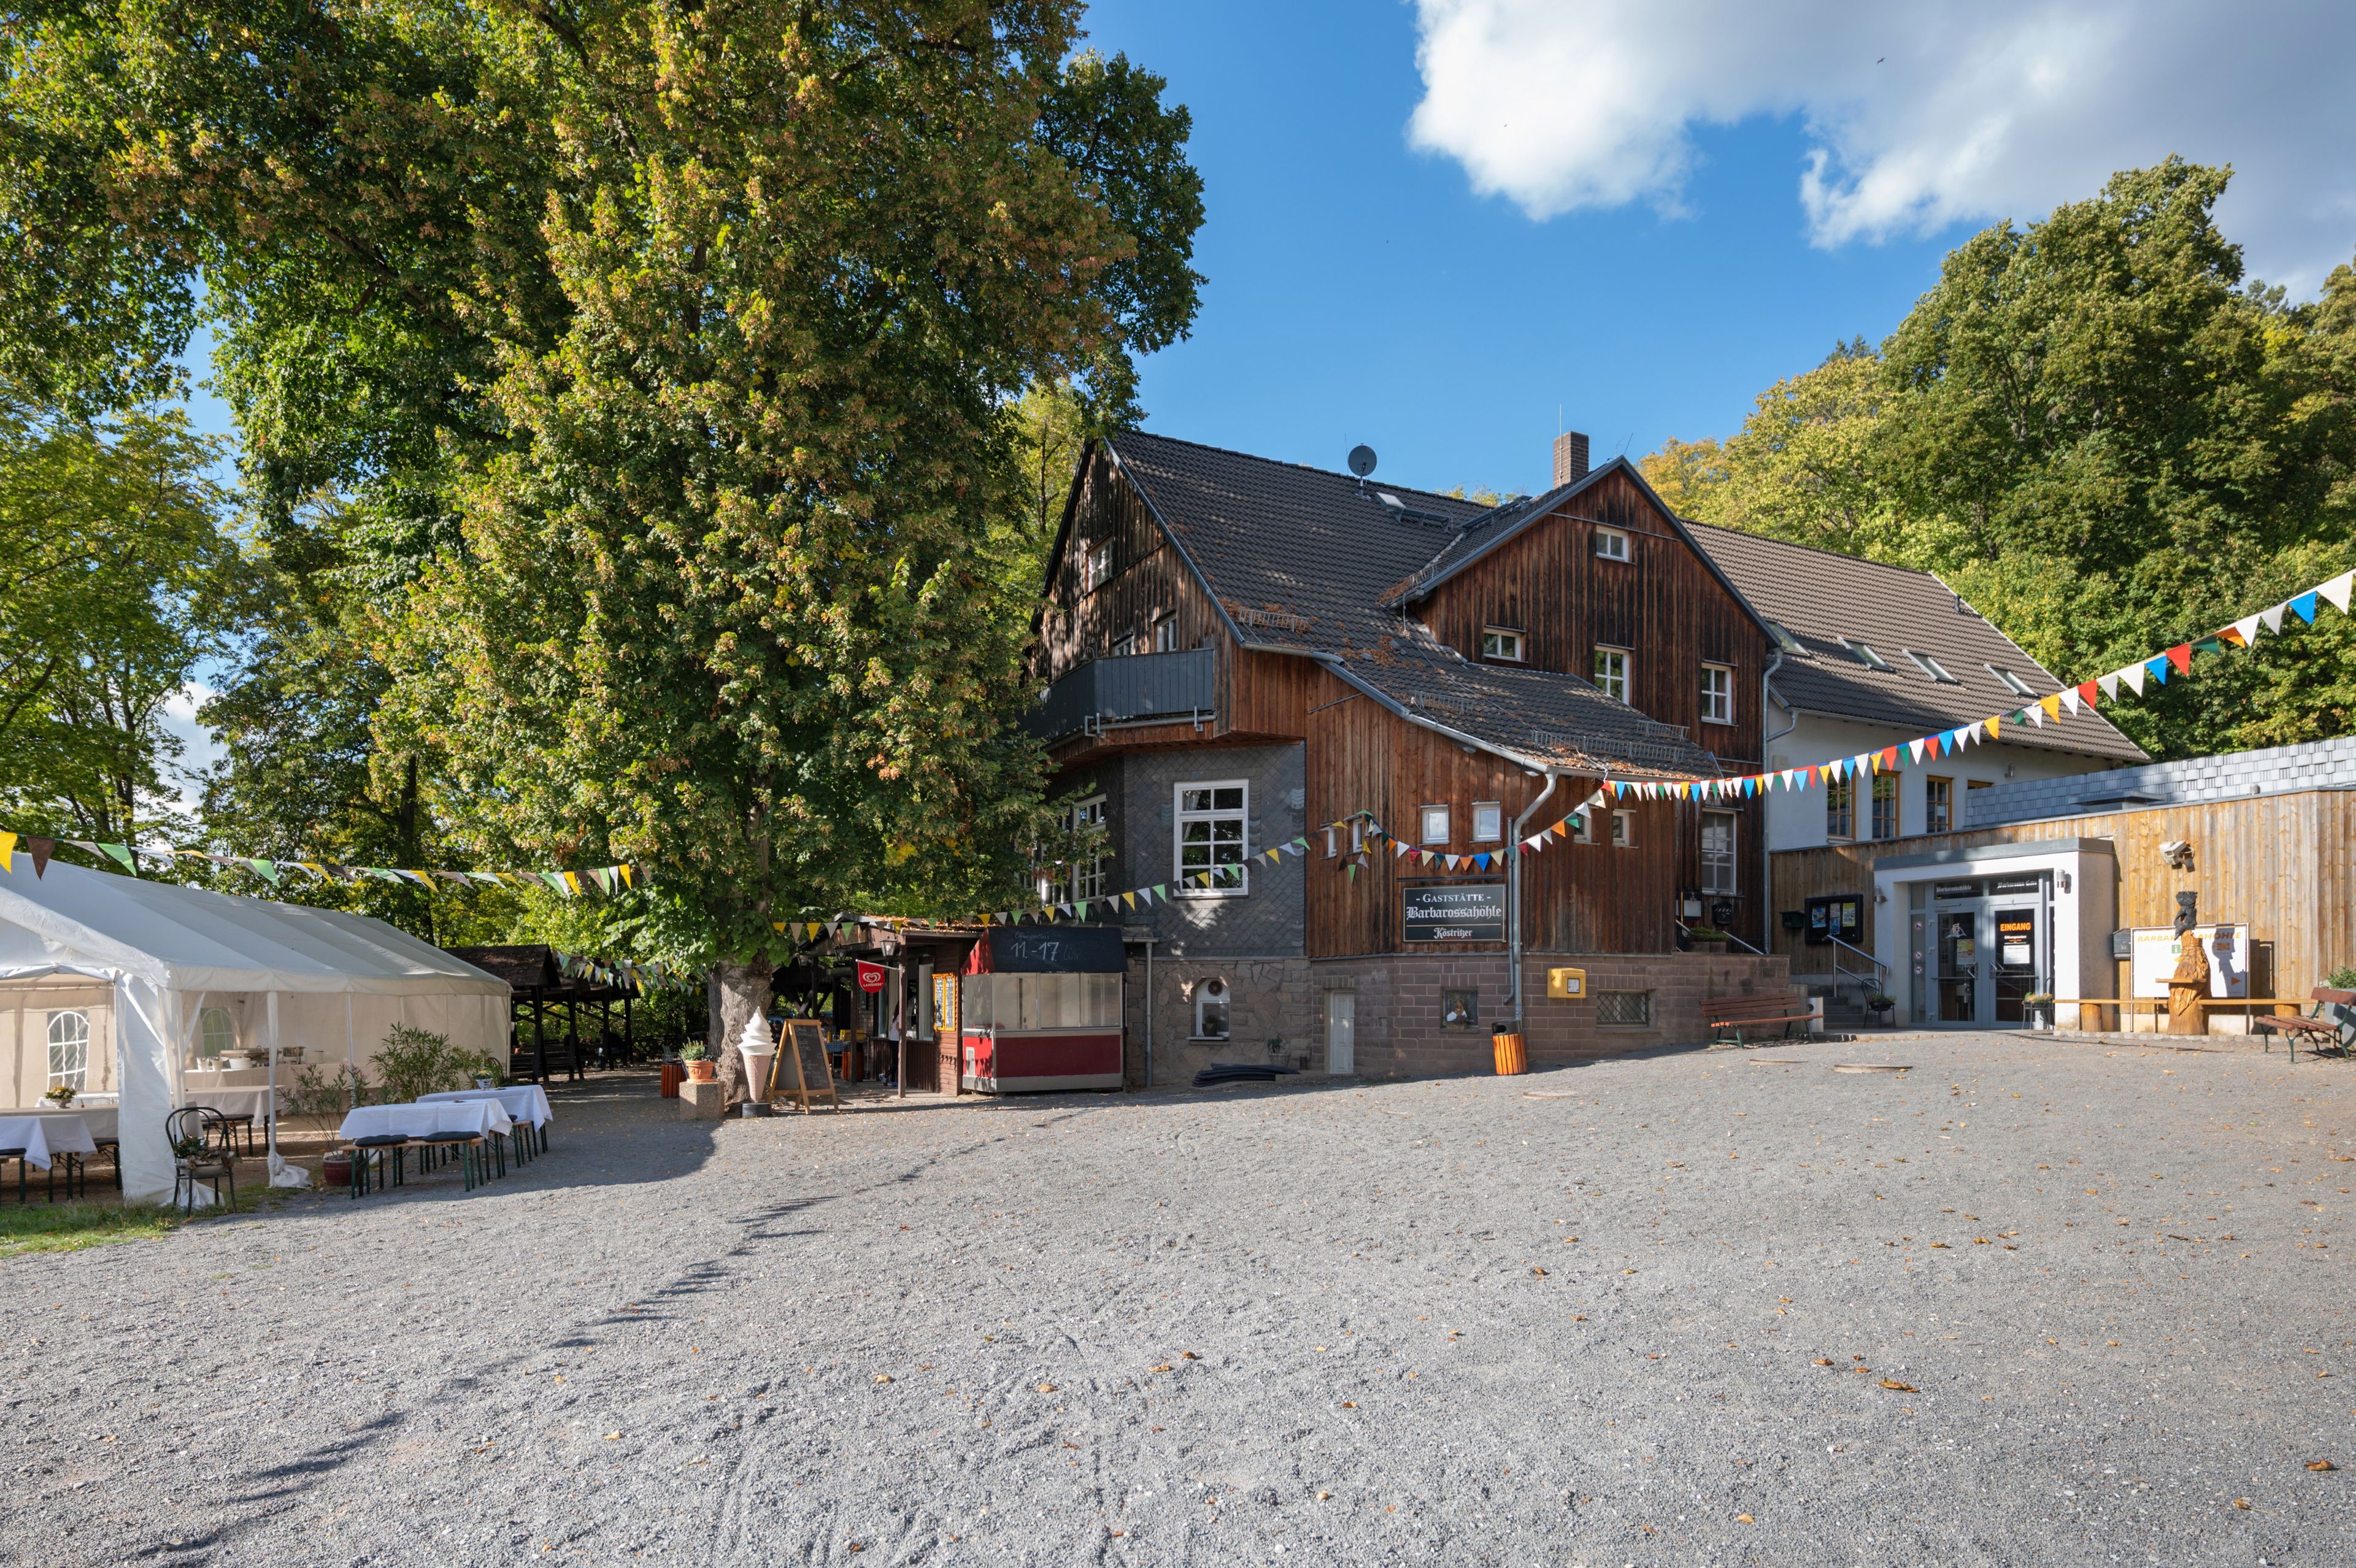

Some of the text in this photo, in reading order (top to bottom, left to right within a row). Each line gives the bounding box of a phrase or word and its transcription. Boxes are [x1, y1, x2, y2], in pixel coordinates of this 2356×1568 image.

[1422, 893, 1485, 903] GASTSTÄTTE
[1406, 905, 1503, 921] Barbarossahöhle
[2000, 922, 2031, 932] EINGANG
[1433, 927, 1473, 939] Köstritzer
[2138, 932, 2241, 942] BARBARAHÖHLE
